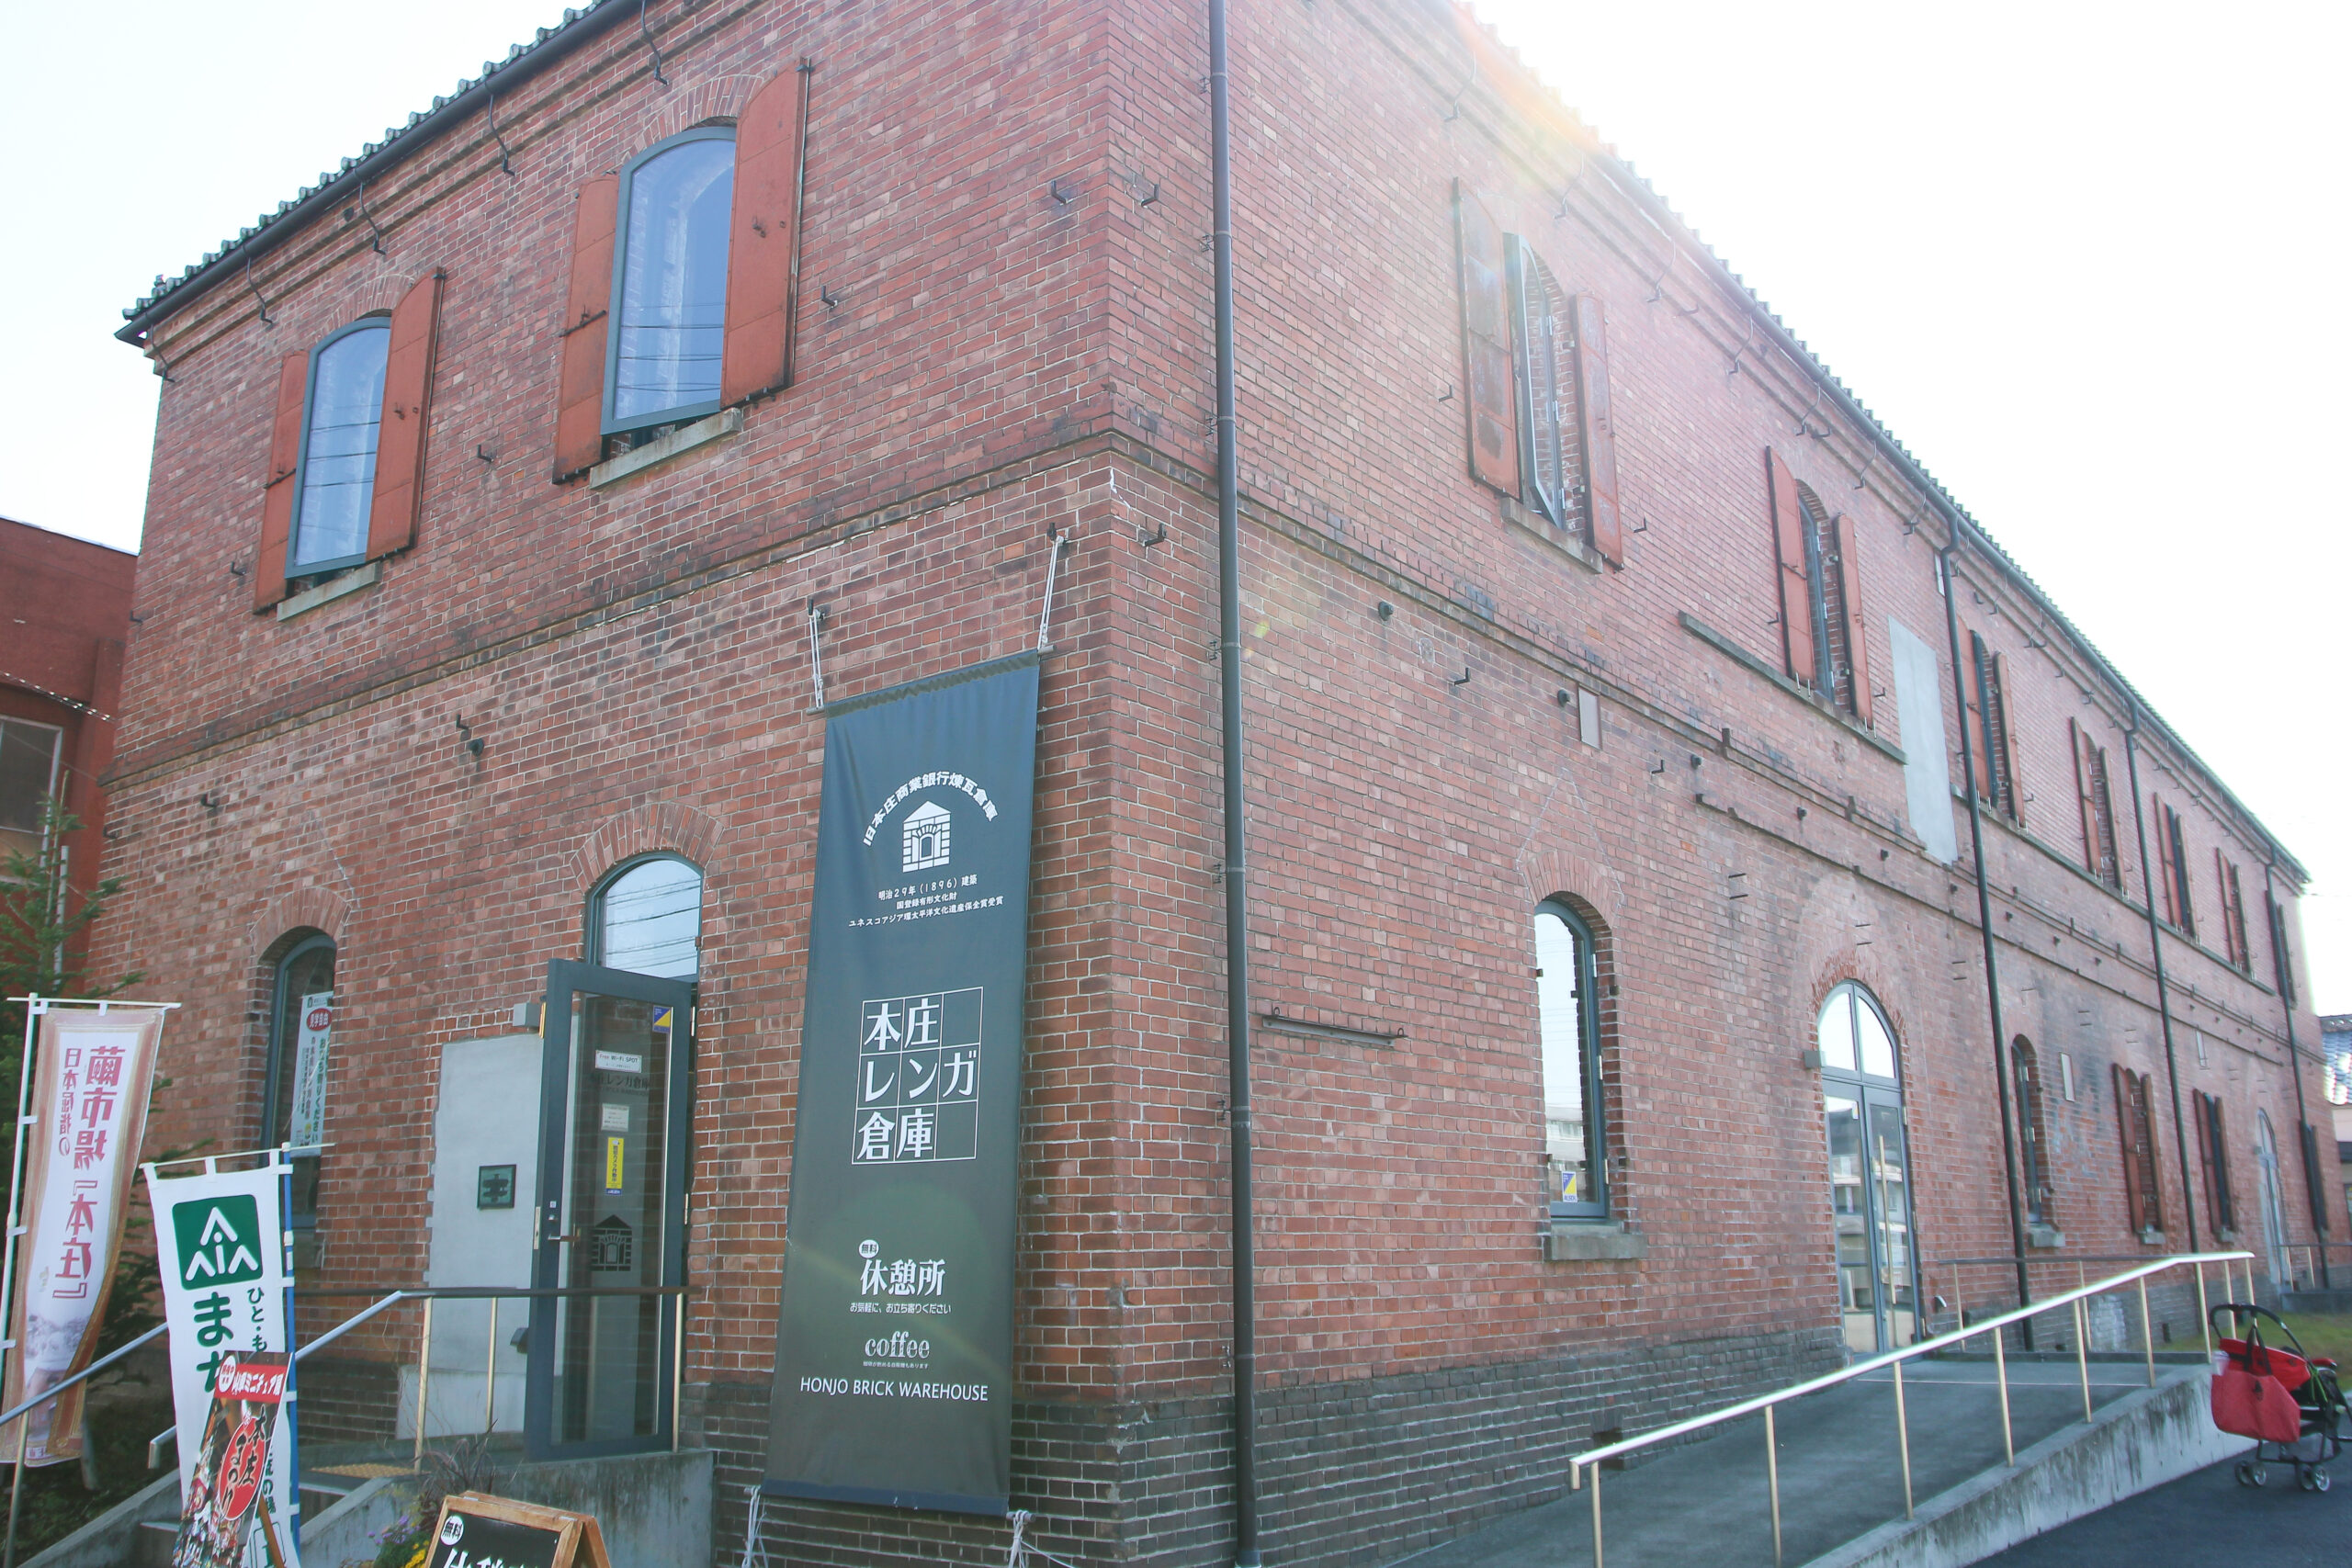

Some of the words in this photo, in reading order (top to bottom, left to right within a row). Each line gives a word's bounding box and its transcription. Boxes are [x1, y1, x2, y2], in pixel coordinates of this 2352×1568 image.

[863, 771, 999, 846] 旧本庄商業銀行煉瓦倉庫
[896, 892, 957, 910] 国登録有形文化財
[864, 998, 940, 1051] 本庄
[865, 1050, 977, 1102] レンガ
[856, 1108, 934, 1160] 倉庫
[861, 1244, 877, 1255] 無料
[860, 1258, 946, 1296] 休憩所
[850, 1302, 952, 1314] お気軽に、お立ち寄りください
[865, 1330, 930, 1359] coffee
[800, 1376, 849, 1395] HONJO
[853, 1380, 894, 1396] BRICK
[899, 1382, 989, 1401] WAREHOUSE
[238, 1404, 266, 1485] 本庄
[220, 1432, 247, 1511] まつり
[443, 1522, 461, 1540] 無料
